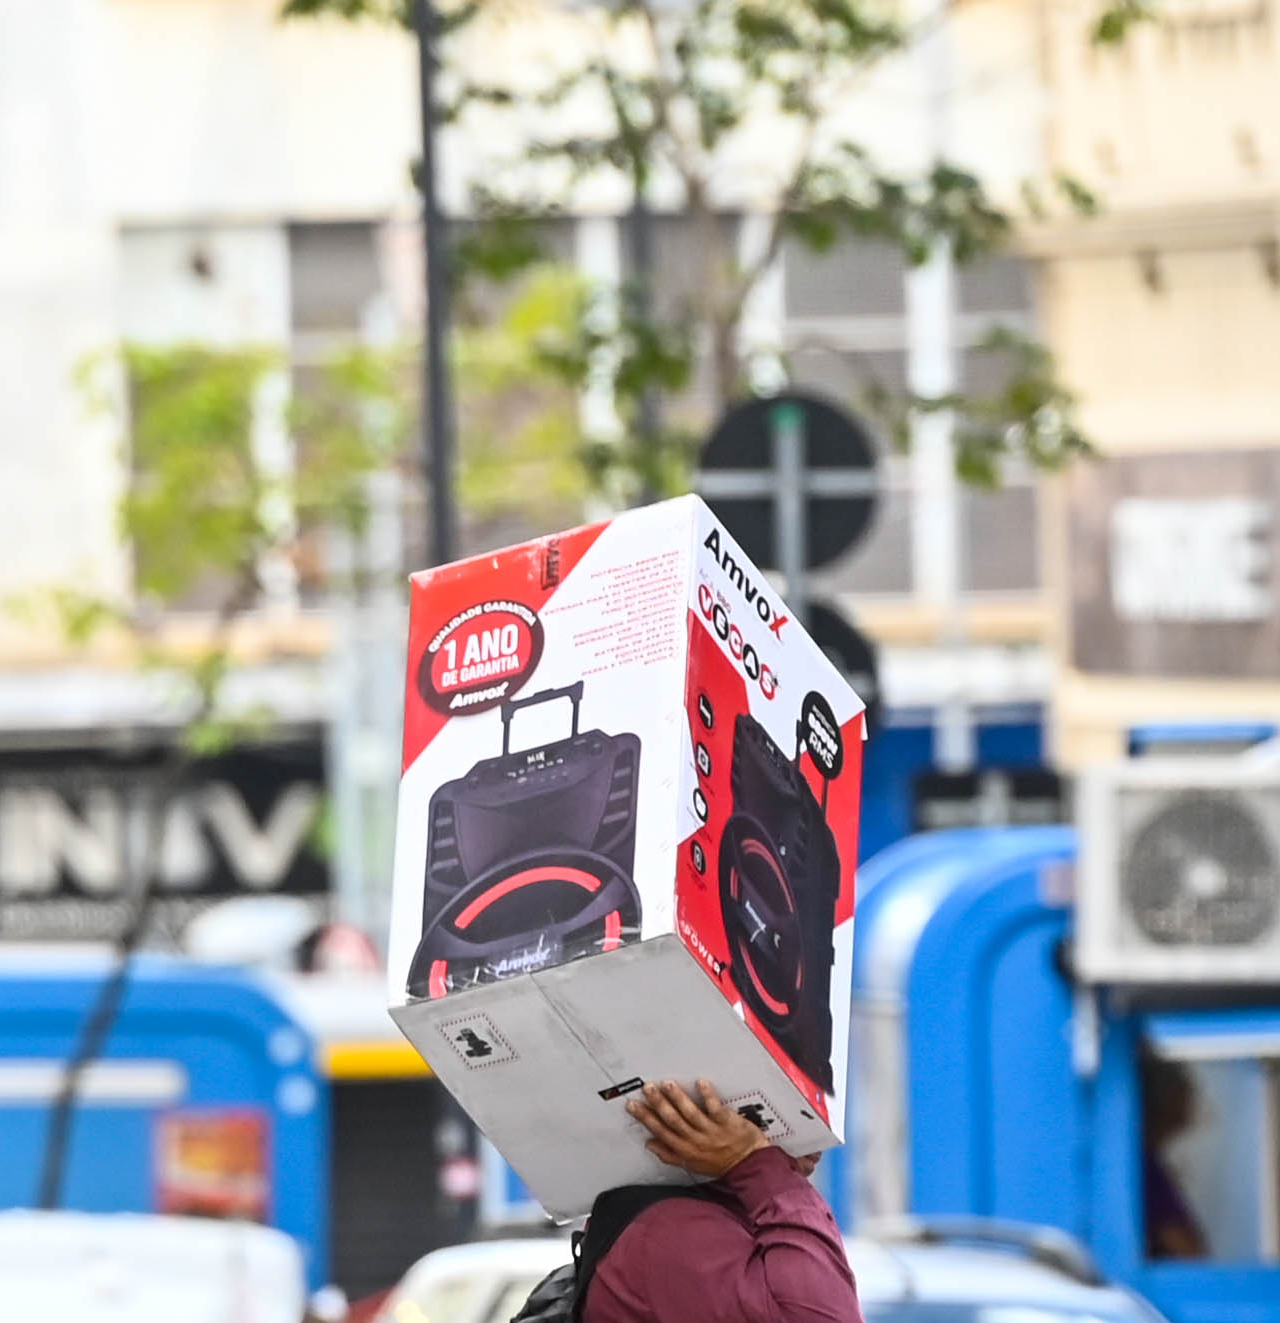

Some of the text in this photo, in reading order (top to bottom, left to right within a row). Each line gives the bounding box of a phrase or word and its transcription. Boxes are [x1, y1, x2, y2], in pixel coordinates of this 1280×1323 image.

[703, 527, 789, 641] Amvox
[443, 623, 520, 670] 1 ANO
[441, 654, 520, 688] DE GARANTIA
[448, 680, 510, 709] Amvox
[809, 731, 834, 769] RMS
